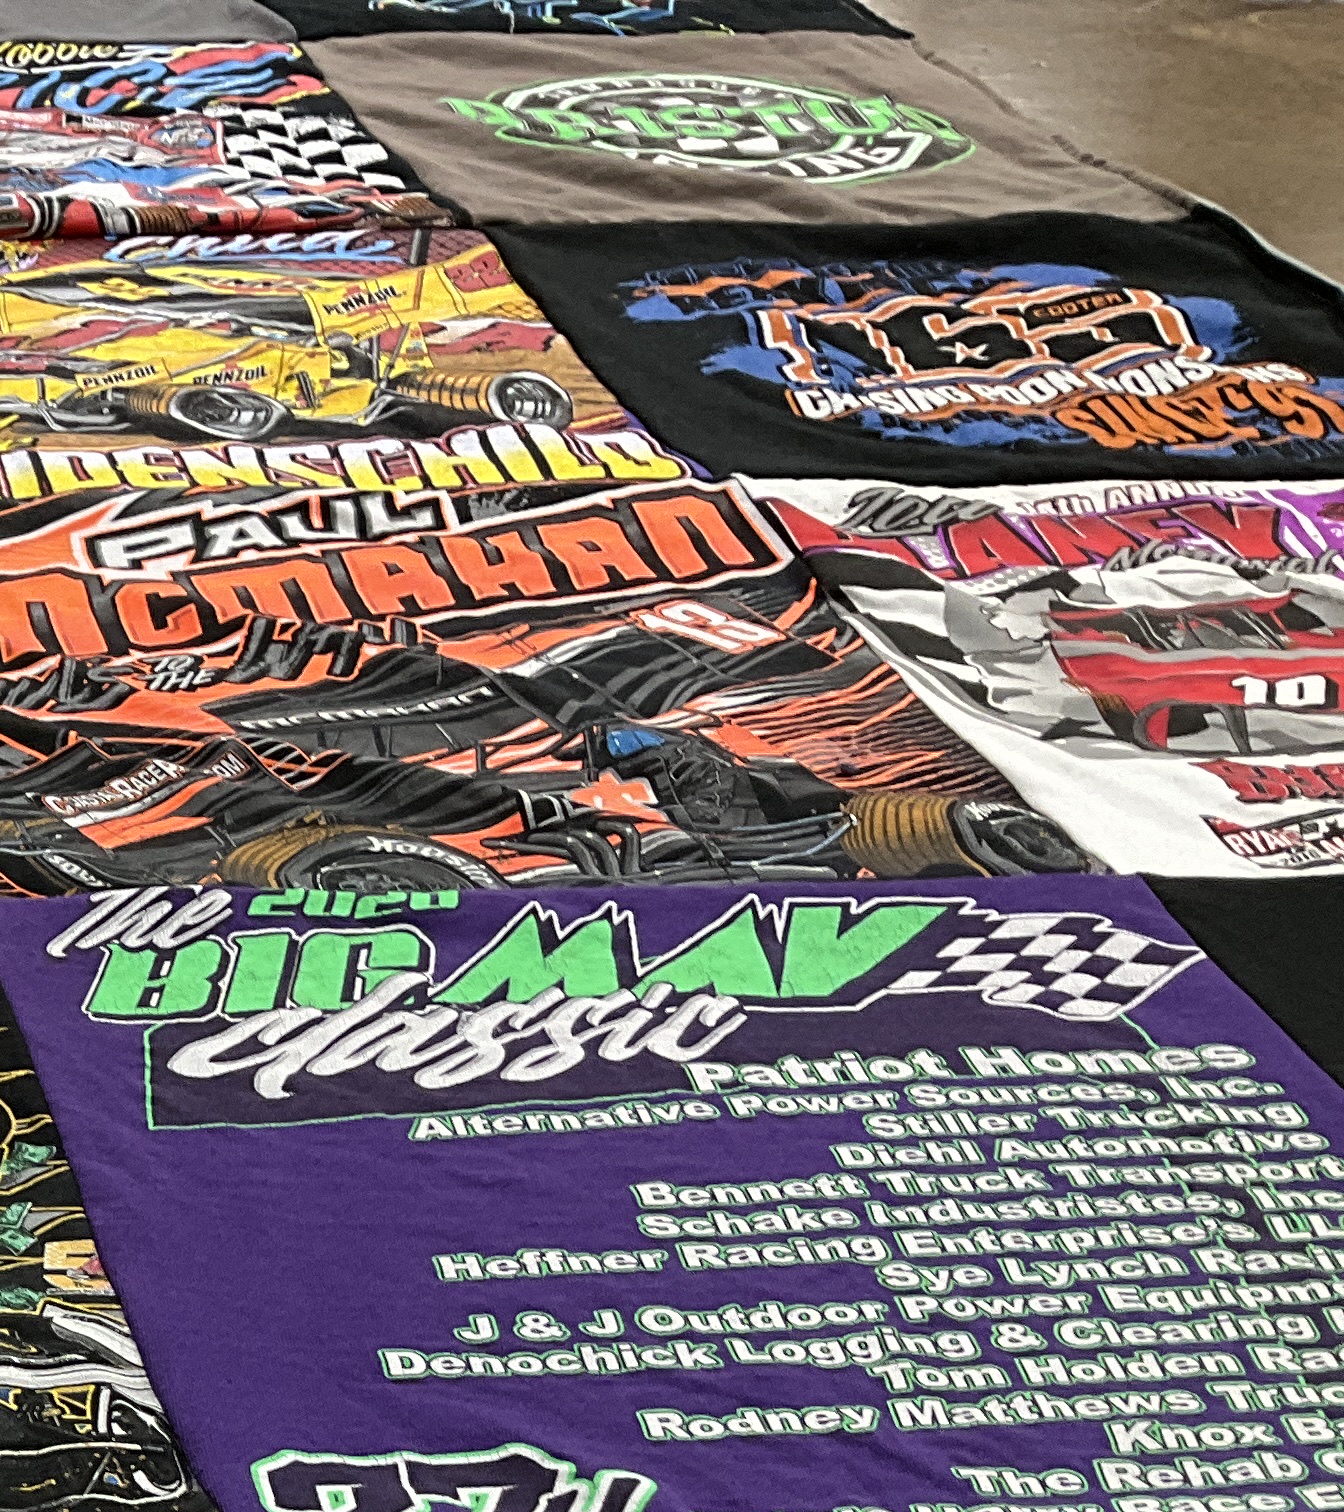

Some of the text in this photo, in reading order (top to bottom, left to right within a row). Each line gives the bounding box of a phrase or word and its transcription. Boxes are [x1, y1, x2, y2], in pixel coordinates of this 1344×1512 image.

[324, 285, 402, 316] PENNZOIL
[81, 364, 158, 388] PENNZOIL
[191, 366, 269, 386] PENNZOIL
[85, 493, 446, 570] PAUL
[632, 599, 786, 663] 13
[149, 668, 215, 691] THE
[151, 655, 194, 672] TO
[1230, 674, 1330, 707] 10
[48, 883, 237, 957] The
[85, 925, 434, 1017] BIG
[167, 971, 747, 1099] classic
[689, 1043, 1257, 1092] Patriot Homes
[408, 1074, 1285, 1141] Alternative Power Sources, Inc.
[862, 1100, 1310, 1140] Stiller Trucking
[831, 1126, 1330, 1169] Diehl Automotive
[629, 1172, 870, 1209] Bennett
[869, 1165, 1053, 1199] Truck
[636, 1203, 859, 1239] Schake
[432, 1211, 1344, 1283] Heffner Racing Enterprise's LL
[875, 1258, 994, 1294] Sye
[998, 1250, 1191, 1289] Lynch
[453, 1278, 1344, 1344] J & J Outdoor Power Equipm
[380, 1311, 1322, 1382] Denochick Logging & Clearing
[868, 1358, 1012, 1396] Tom
[1017, 1350, 1243, 1387] Holden
[637, 1403, 880, 1443] Rodney
[886, 1388, 1207, 1434] Matthews
[1103, 1419, 1284, 1457] Knox
[952, 1450, 1310, 1499] The Rehab
